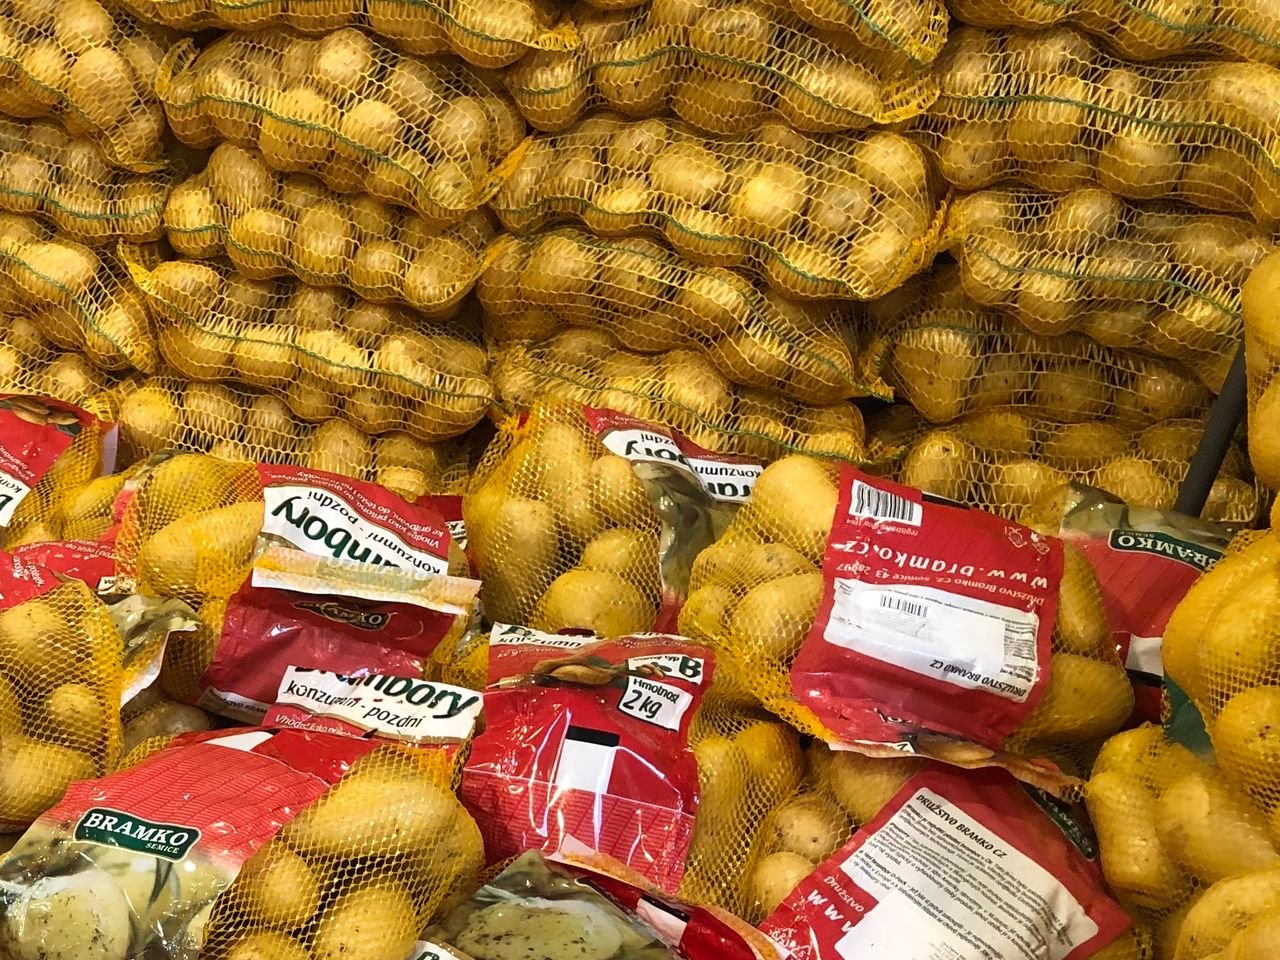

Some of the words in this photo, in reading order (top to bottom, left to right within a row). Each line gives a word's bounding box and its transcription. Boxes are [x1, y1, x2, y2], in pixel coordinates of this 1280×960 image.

[307, 491, 358, 524] pozdní
[368, 530, 441, 575] konzumní
[875, 569, 890, 580] 43
[953, 578, 998, 594] Bramko
[678, 656, 702, 679] B
[929, 659, 945, 671] CZ
[949, 664, 982, 683] BRAMKO
[633, 678, 681, 705] Hmotnost
[983, 676, 1027, 698] DRUŽSTVO
[362, 703, 427, 729] pozdní
[622, 690, 643, 710] 2
[643, 695, 663, 719] kg
[84, 812, 190, 847] BRAMKO
[916, 794, 959, 826] DRUŽSTVO
[956, 822, 993, 852] BRAMKO
[991, 847, 1008, 860] CZ
[145, 841, 180, 854] SEMICE
[823, 875, 865, 913] Družstvo
